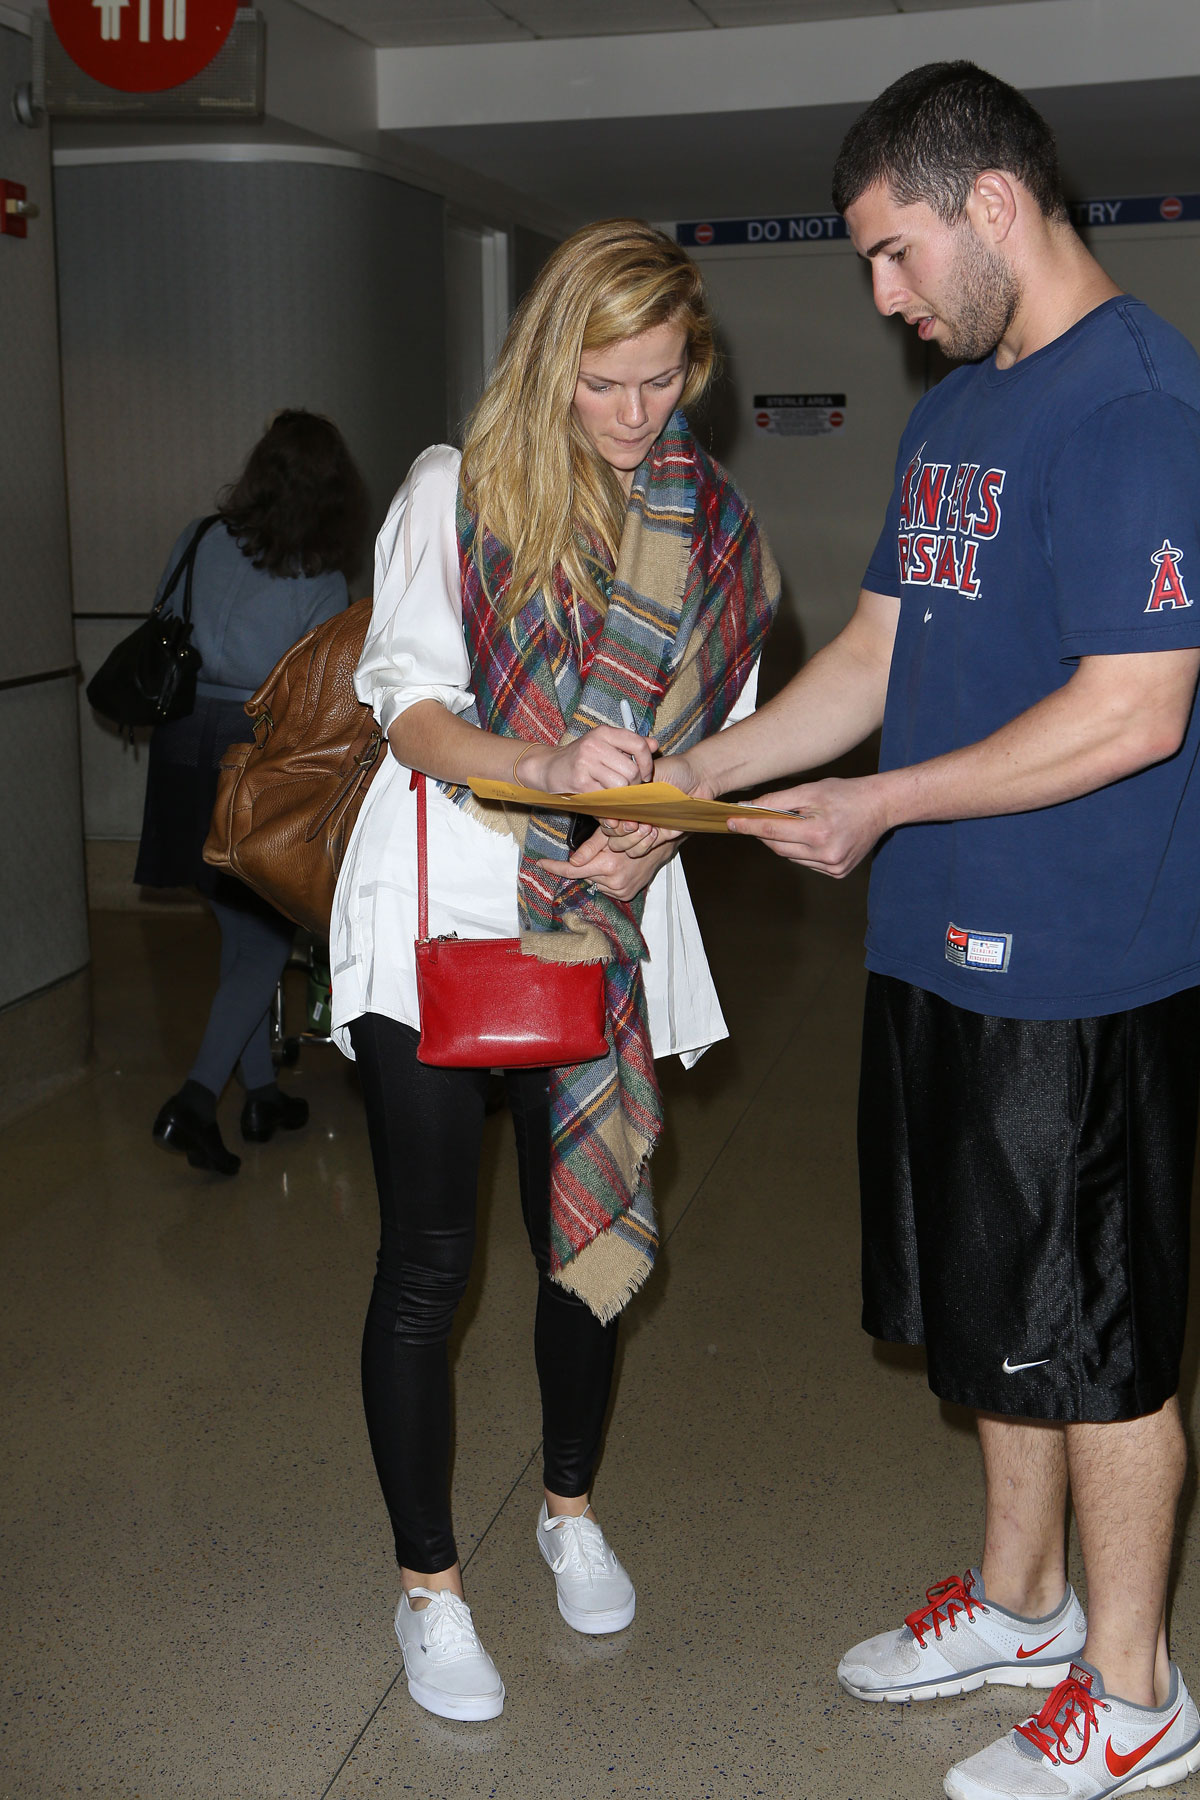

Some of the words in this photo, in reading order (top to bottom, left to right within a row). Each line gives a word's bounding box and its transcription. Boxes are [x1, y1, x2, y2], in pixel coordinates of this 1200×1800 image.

[747, 221, 782, 241] DO
[788, 218, 838, 239] NOT
[807, 396, 833, 405] AREA
[1143, 539, 1191, 612] A
[948, 941, 964, 951] TEAM
[1070, 1667, 1090, 1684] NIKE
